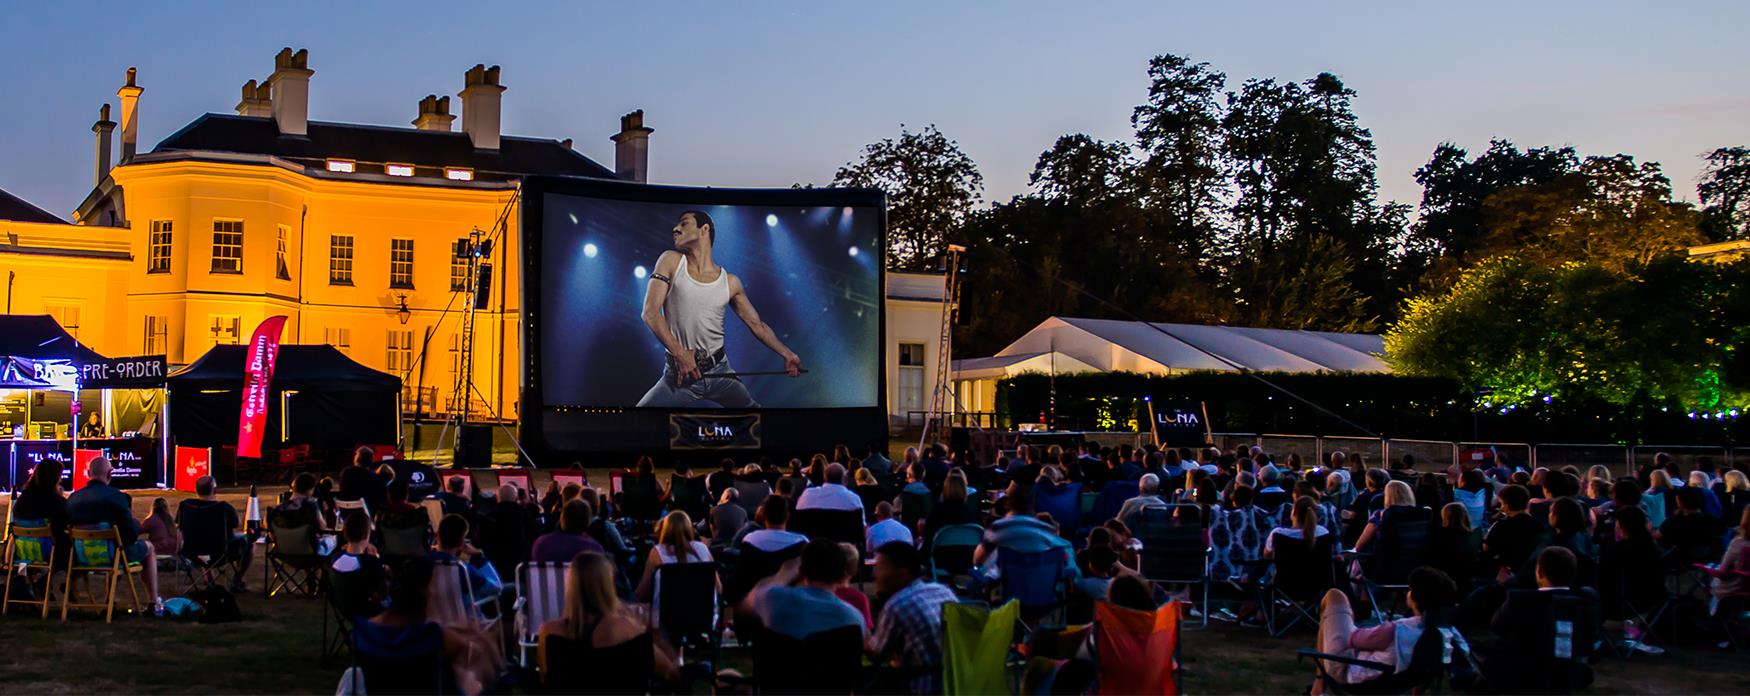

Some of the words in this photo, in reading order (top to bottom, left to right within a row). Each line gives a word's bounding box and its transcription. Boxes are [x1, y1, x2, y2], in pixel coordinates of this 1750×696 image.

[251, 335, 267, 371] Damm
[83, 361, 162, 380] PRE-ORDER
[1158, 413, 1198, 423] LUNA
[698, 426, 733, 437] LUNA
[106, 451, 135, 461] LUNA
